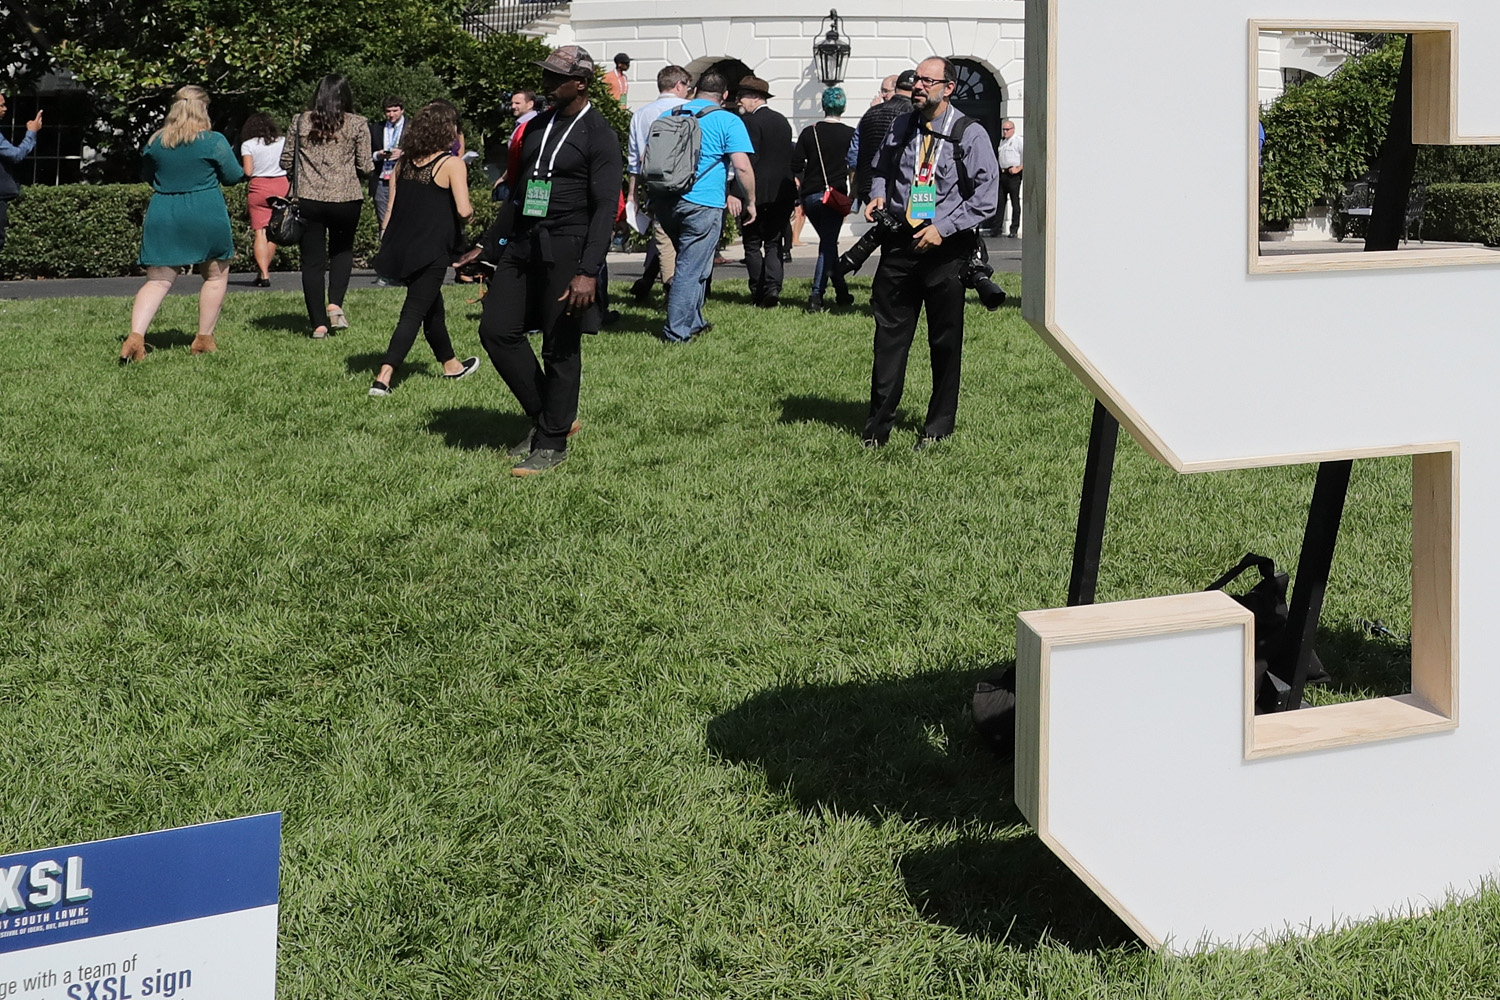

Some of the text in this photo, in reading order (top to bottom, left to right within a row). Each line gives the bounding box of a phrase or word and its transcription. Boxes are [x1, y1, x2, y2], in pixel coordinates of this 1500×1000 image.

[912, 193, 934, 202] SXSL
[14, 912, 50, 927] SOUTH
[55, 907, 89, 920] LAWN:
[70, 917, 89, 926] ACTION
[23, 969, 57, 992] with
[63, 970, 72, 984] a
[78, 962, 116, 981] team
[123, 954, 137, 973] of
[67, 968, 192, 1000] SXSL sign
